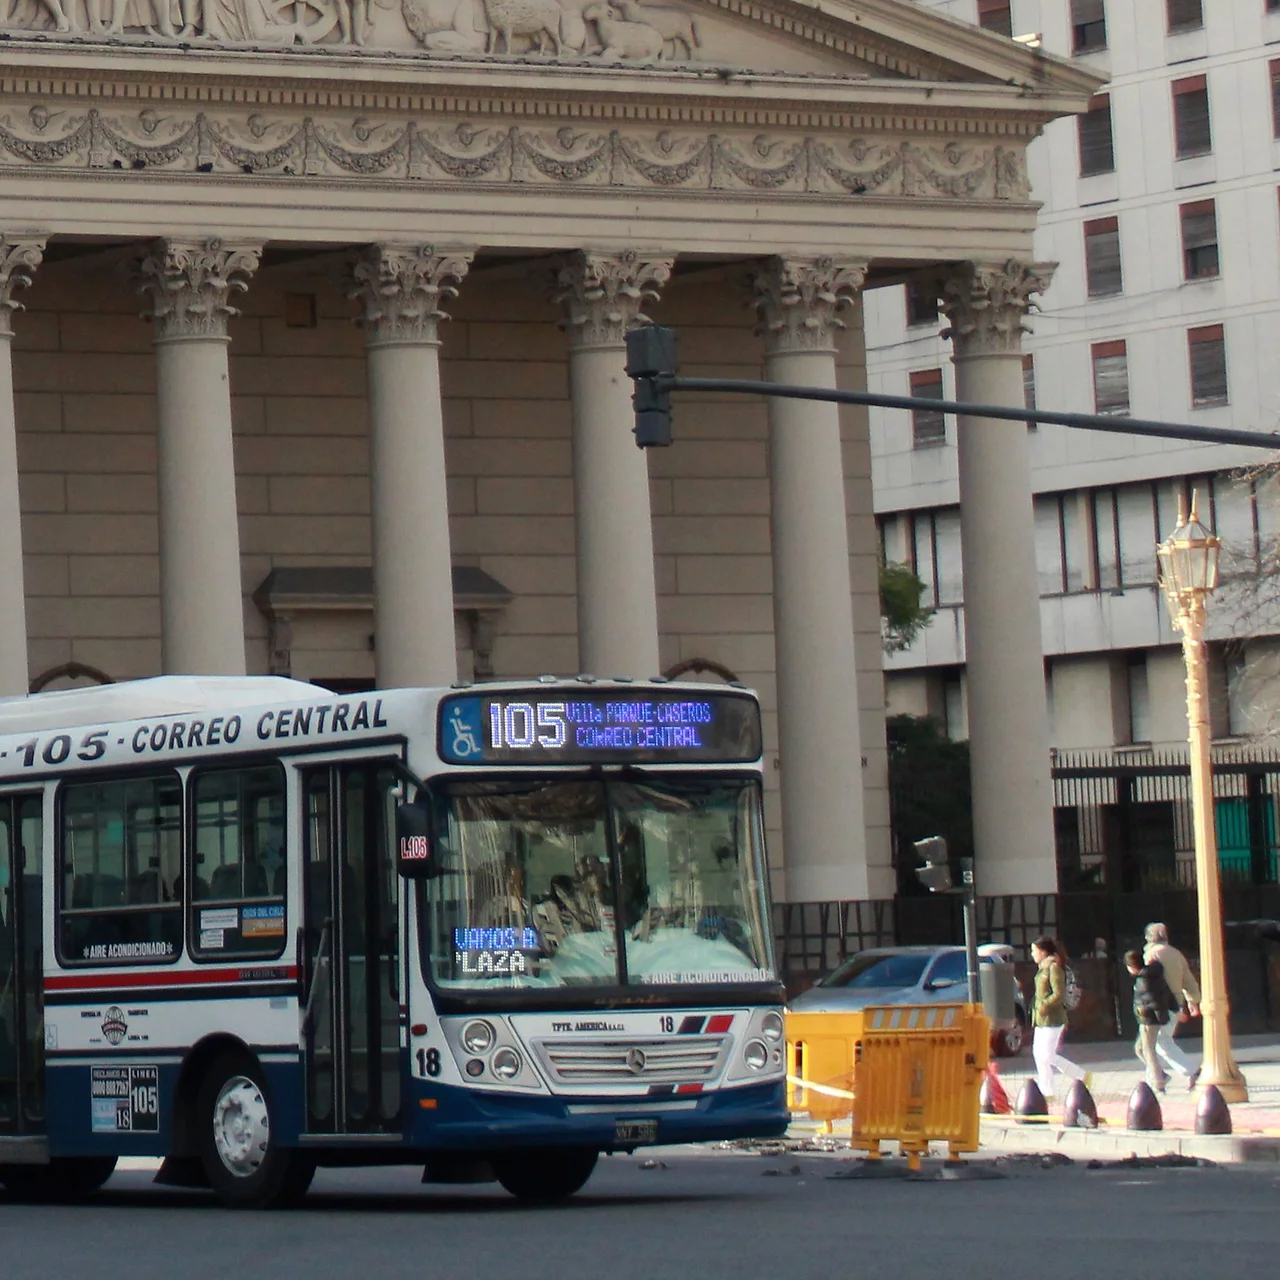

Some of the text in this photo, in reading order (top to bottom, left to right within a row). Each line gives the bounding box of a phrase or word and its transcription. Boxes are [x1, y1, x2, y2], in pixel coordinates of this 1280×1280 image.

[15, 729, 110, 768] 105
[131, 714, 242, 754] CORREO
[256, 698, 388, 741] CENTRAL
[490, 702, 566, 748] 105
[636, 726, 702, 747] CENTRAL
[455, 927, 534, 950] VAMOS A
[89, 941, 167, 958] AIRE ACONDICIONADO
[651, 969, 767, 984] AIRE ACONDICIONADO
[575, 1021, 608, 1031] AMERICA
[659, 1015, 674, 1033] 18
[415, 1047, 441, 1077] 18
[131, 1069, 157, 1079] LINEA
[131, 1086, 158, 1114] 105
[117, 1109, 130, 1128] 18
